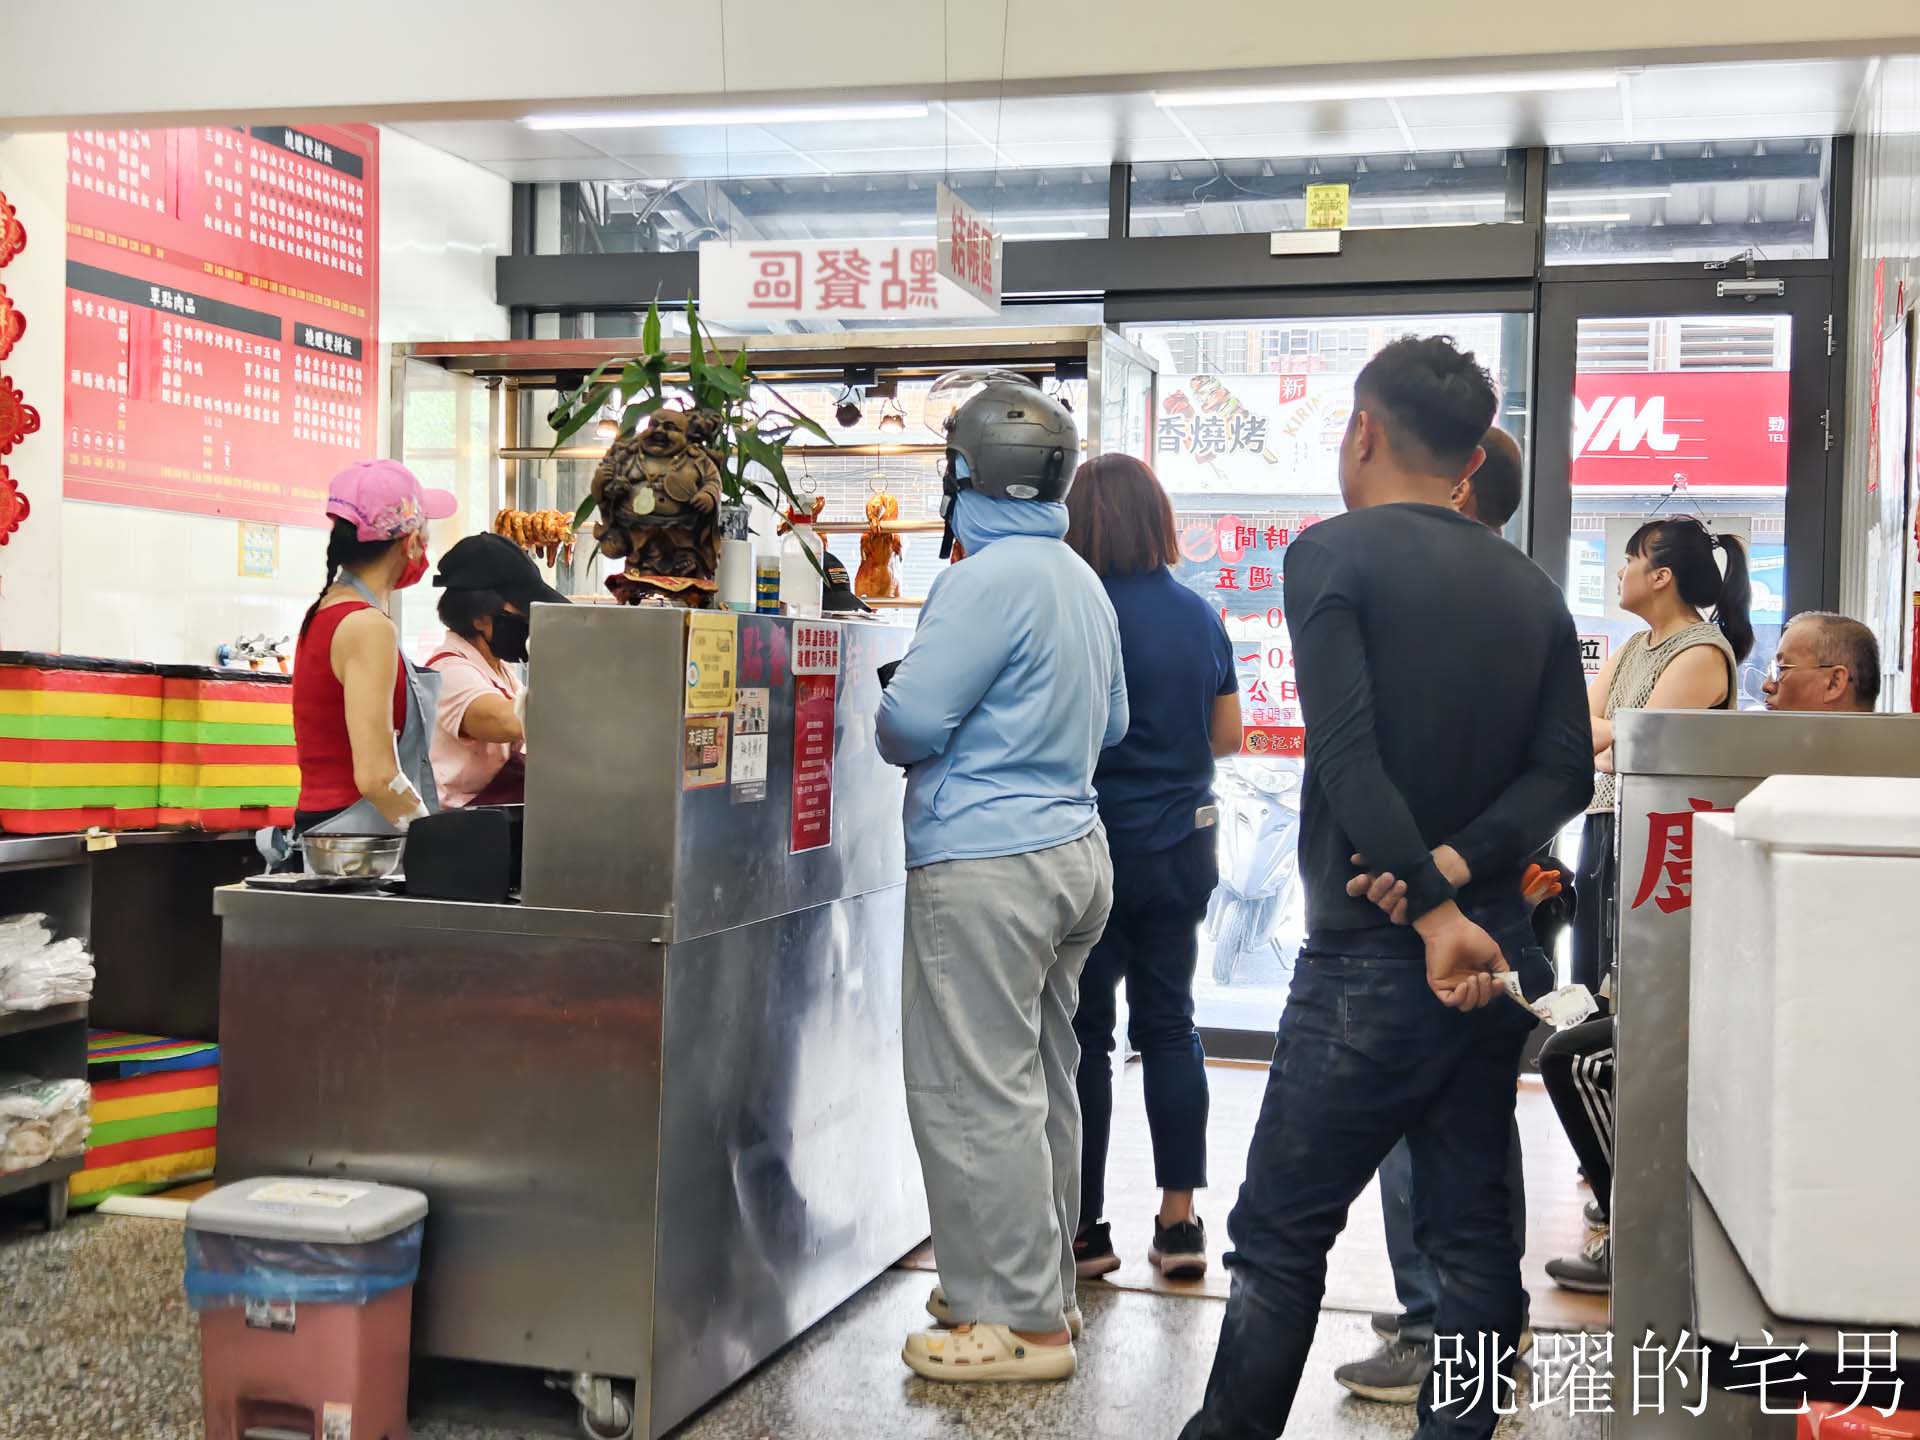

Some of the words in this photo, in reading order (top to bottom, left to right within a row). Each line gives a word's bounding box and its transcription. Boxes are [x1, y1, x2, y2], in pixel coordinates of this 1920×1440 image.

[284, 129, 333, 165] 燒臘雙拼飯
[149, 286, 196, 315] 單點肉品
[305, 327, 352, 355] 燒臘雙拼飯
[1281, 377, 1304, 399] 新
[1583, 663, 1600, 671] ULL
